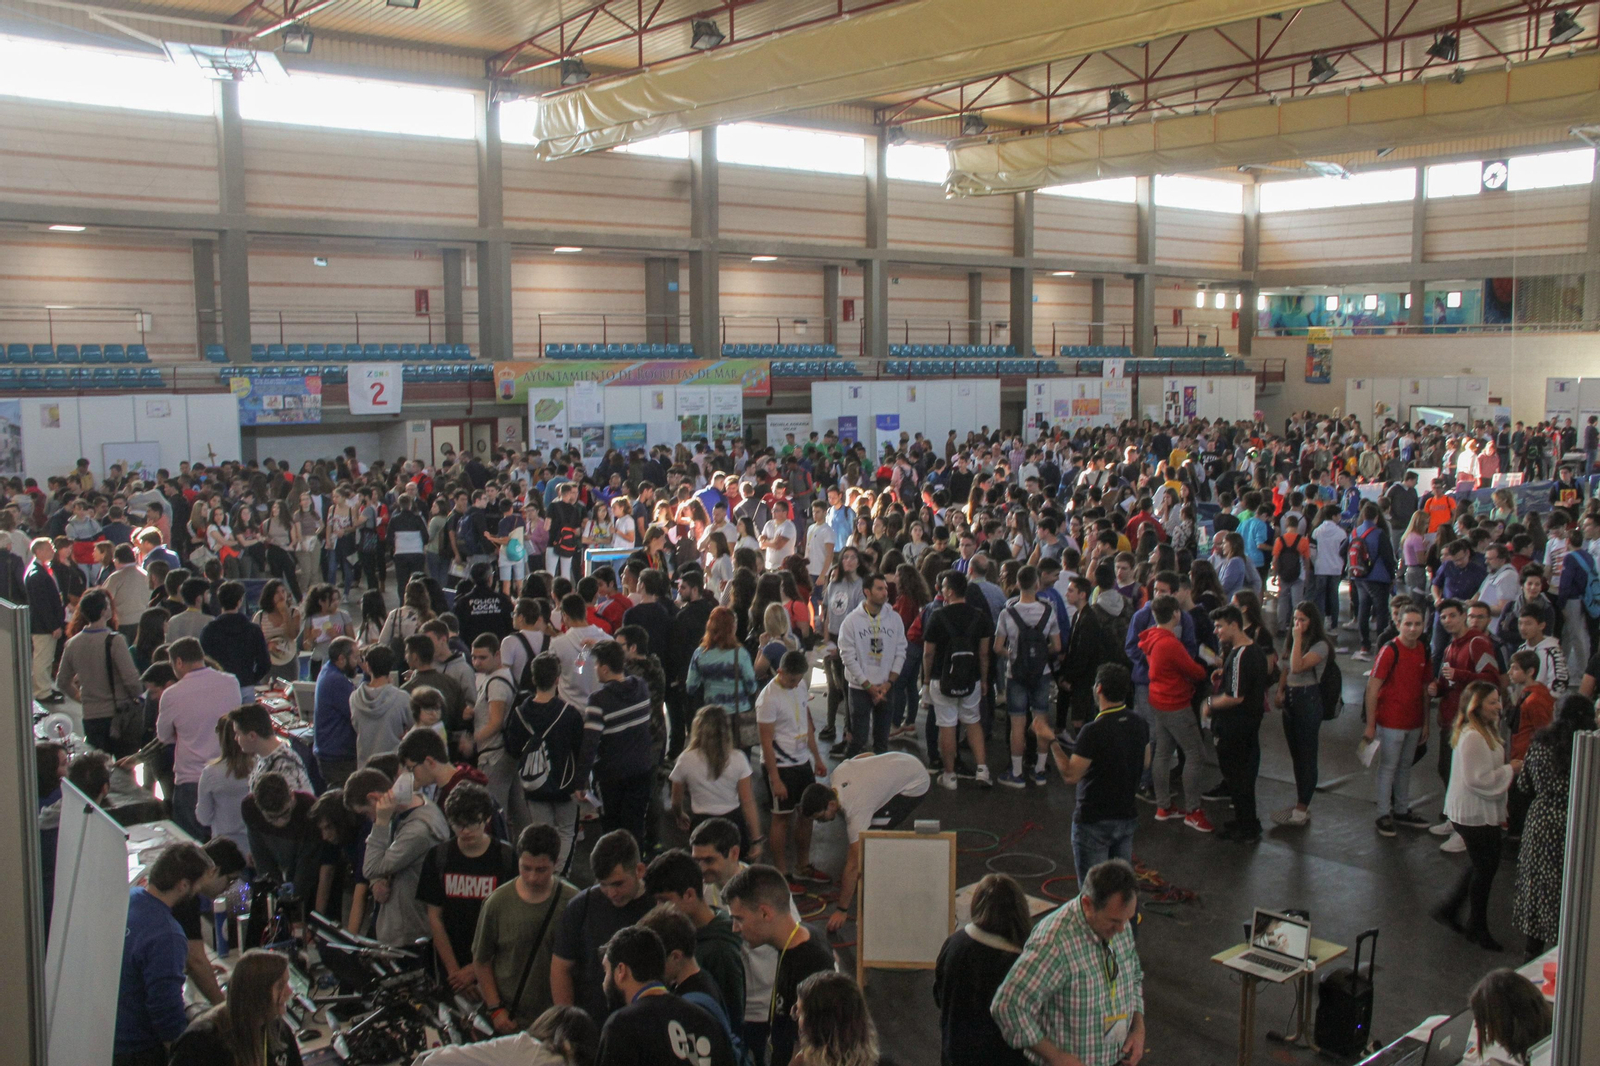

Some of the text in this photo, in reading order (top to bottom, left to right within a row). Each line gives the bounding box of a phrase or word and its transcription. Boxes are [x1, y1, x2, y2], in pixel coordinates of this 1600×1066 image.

[366, 370, 390, 378] ZONA
[523, 370, 615, 382] AYUNTAMIENTO
[619, 370, 632, 380] DE
[636, 368, 694, 381] ROQUETAS
[698, 368, 711, 379] DE
[1109, 367, 1116, 378] 1
[369, 382, 388, 405] 2
[472, 603, 500, 611] LOCAL
[445, 874, 494, 897] MARVEL
